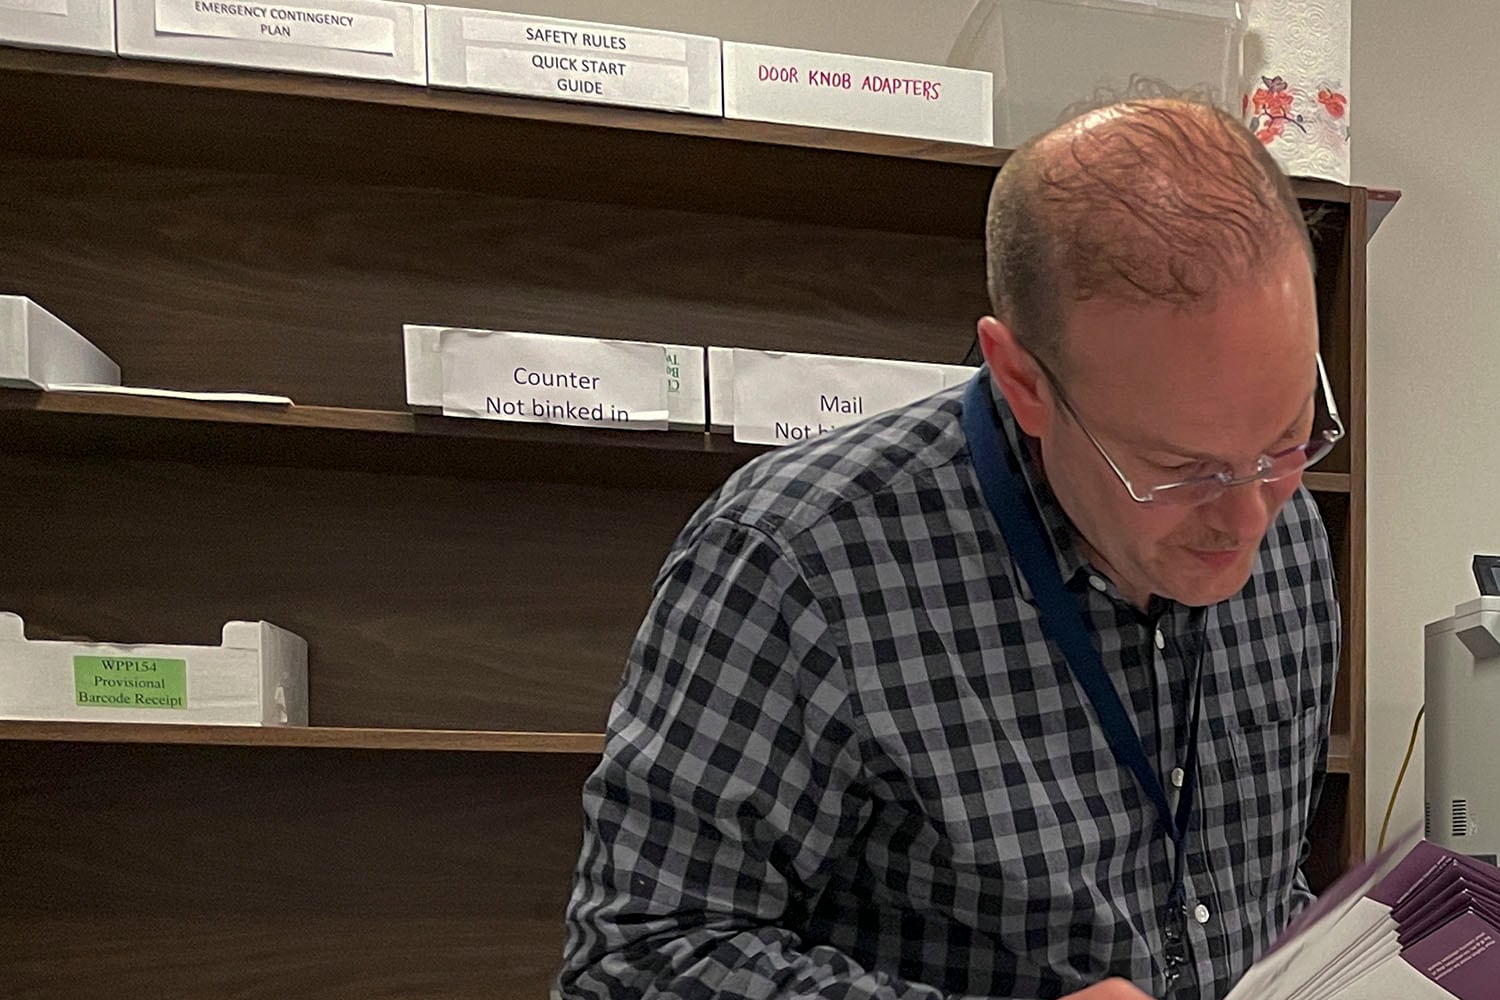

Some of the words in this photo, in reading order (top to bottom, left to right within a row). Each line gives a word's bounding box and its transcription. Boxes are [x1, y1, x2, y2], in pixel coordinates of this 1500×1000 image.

[194, 2, 267, 18] EMERGENCY
[270, 8, 354, 26] CONTINGENCY
[260, 24, 291, 37] PLAN
[526, 27, 578, 45] SAFETY
[582, 33, 627, 50] RULES
[531, 55, 578, 72] QUICK
[581, 60, 627, 76] START
[556, 78, 603, 95] GUIDE
[758, 64, 799, 83] DOOR
[808, 70, 852, 89] KNOB
[861, 75, 942, 101] ADAPTERS
[513, 367, 600, 390] Counter
[485, 396, 525, 416] Not
[532, 398, 604, 421] binked
[611, 405, 629, 422] in
[820, 395, 864, 415] Mail
[775, 422, 811, 440] Not
[102, 660, 157, 673] WPP154
[94, 675, 165, 689] Provisional
[78, 691, 130, 705] Barcode
[135, 693, 182, 708] Receipt
